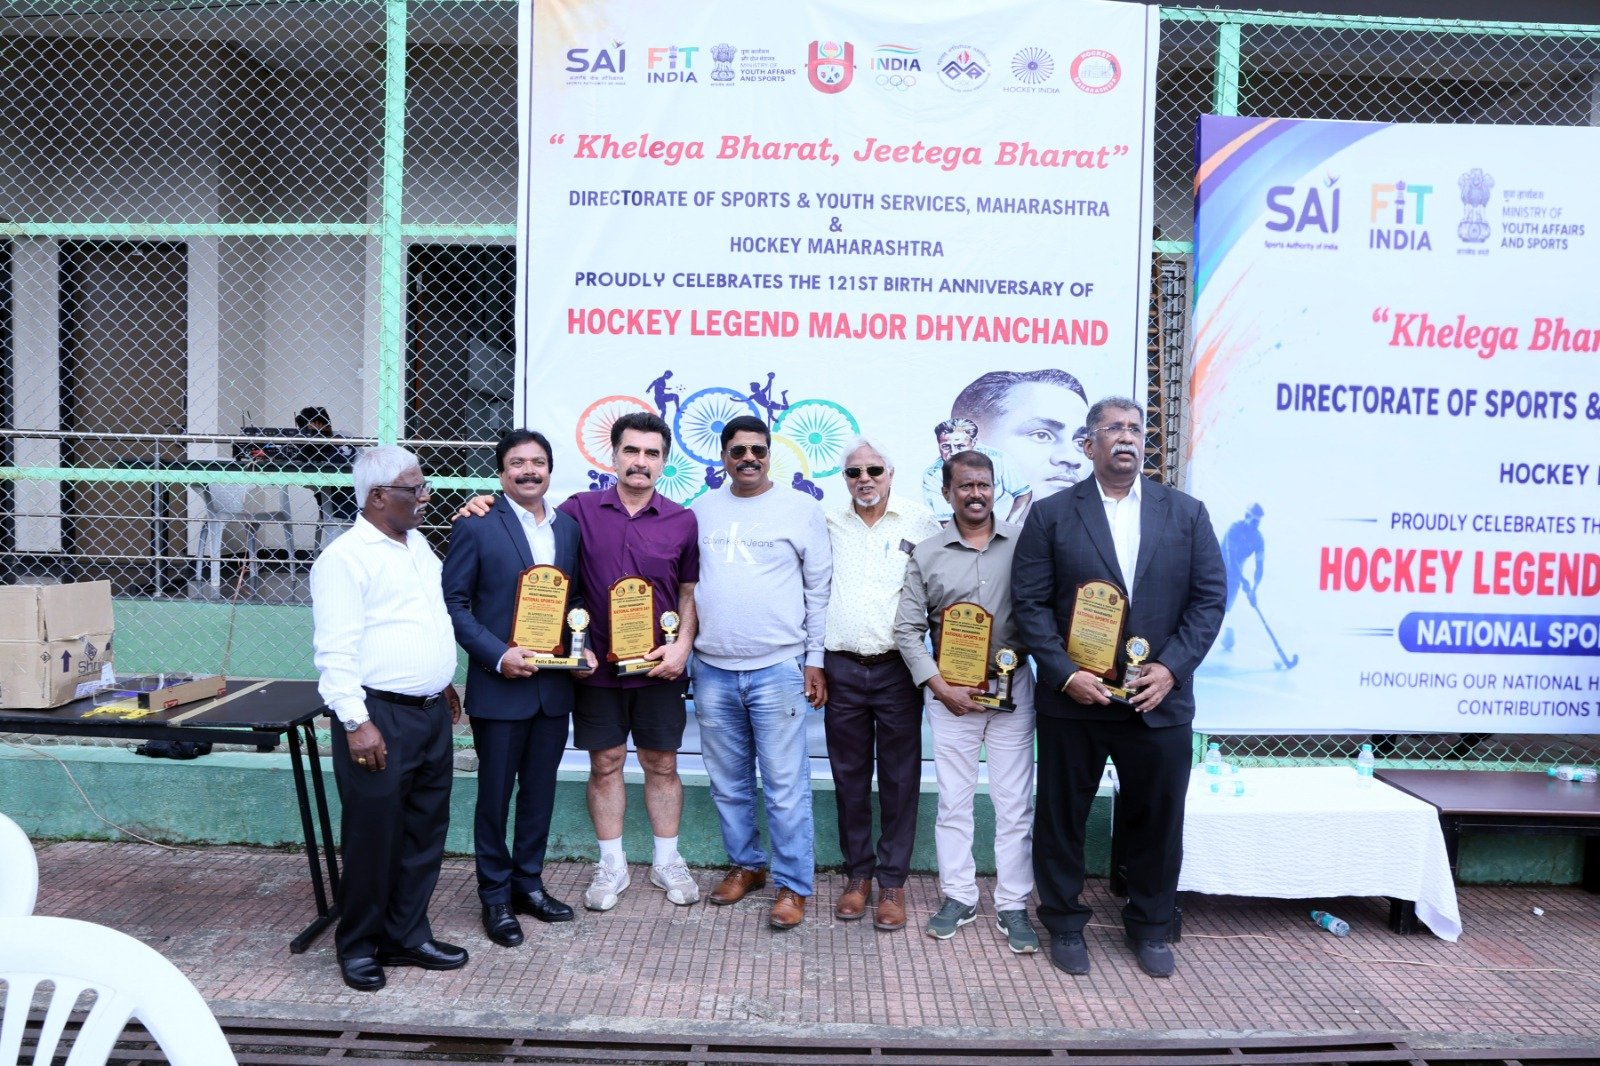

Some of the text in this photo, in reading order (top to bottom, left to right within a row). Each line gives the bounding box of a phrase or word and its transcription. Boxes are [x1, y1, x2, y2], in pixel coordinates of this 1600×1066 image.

[565, 48, 626, 73] SAI
[870, 57, 921, 72] INDIA
[647, 71, 698, 83] INDIA
[1003, 86, 1036, 94] HOCKEY
[574, 133, 704, 166] Khelega
[716, 135, 839, 167] Bharat,
[853, 138, 982, 171] Jeetega
[569, 190, 1110, 217] DIRECTORATE OF SPORTS & YOUTH SERVICES, MAHARASHTRA
[1265, 185, 1340, 234] SAI
[1502, 205, 1563, 219] MINISTRY OF
[828, 216, 843, 232] &
[1501, 222, 1585, 236] YOUTH AFFAIRS
[730, 236, 944, 257] HOCKEY MAHARASHTRA
[1264, 240, 1285, 250] Sports
[1286, 241, 1314, 252] Authority
[1369, 229, 1433, 251] INDIA
[1500, 237, 1568, 250] AND SPORTS
[575, 271, 1094, 298] PROUDLY CELEBRATES THE 121ST BIRTH ANNIVERSARY OF
[567, 307, 1109, 347] HOCKEY LEGEND MAJOR DHYANCHAND
[1276, 383, 1600, 421] DIRECTORATE OF SPORTS &
[1499, 463, 1590, 486] HOCKEY
[1390, 512, 1467, 532] PROUDLY
[1472, 514, 1576, 534] CELEBRATES
[747, 539, 774, 548] Jeans
[1319, 547, 1600, 597] HOCKEY LEGEND
[1417, 619, 1600, 649] NATIONAL SPO
[1360, 671, 1457, 688] HONOURING
[1463, 673, 1497, 689] OUR
[1503, 674, 1583, 691] NATIONAL
[1457, 699, 1590, 717] CONTRIBUTIONS
